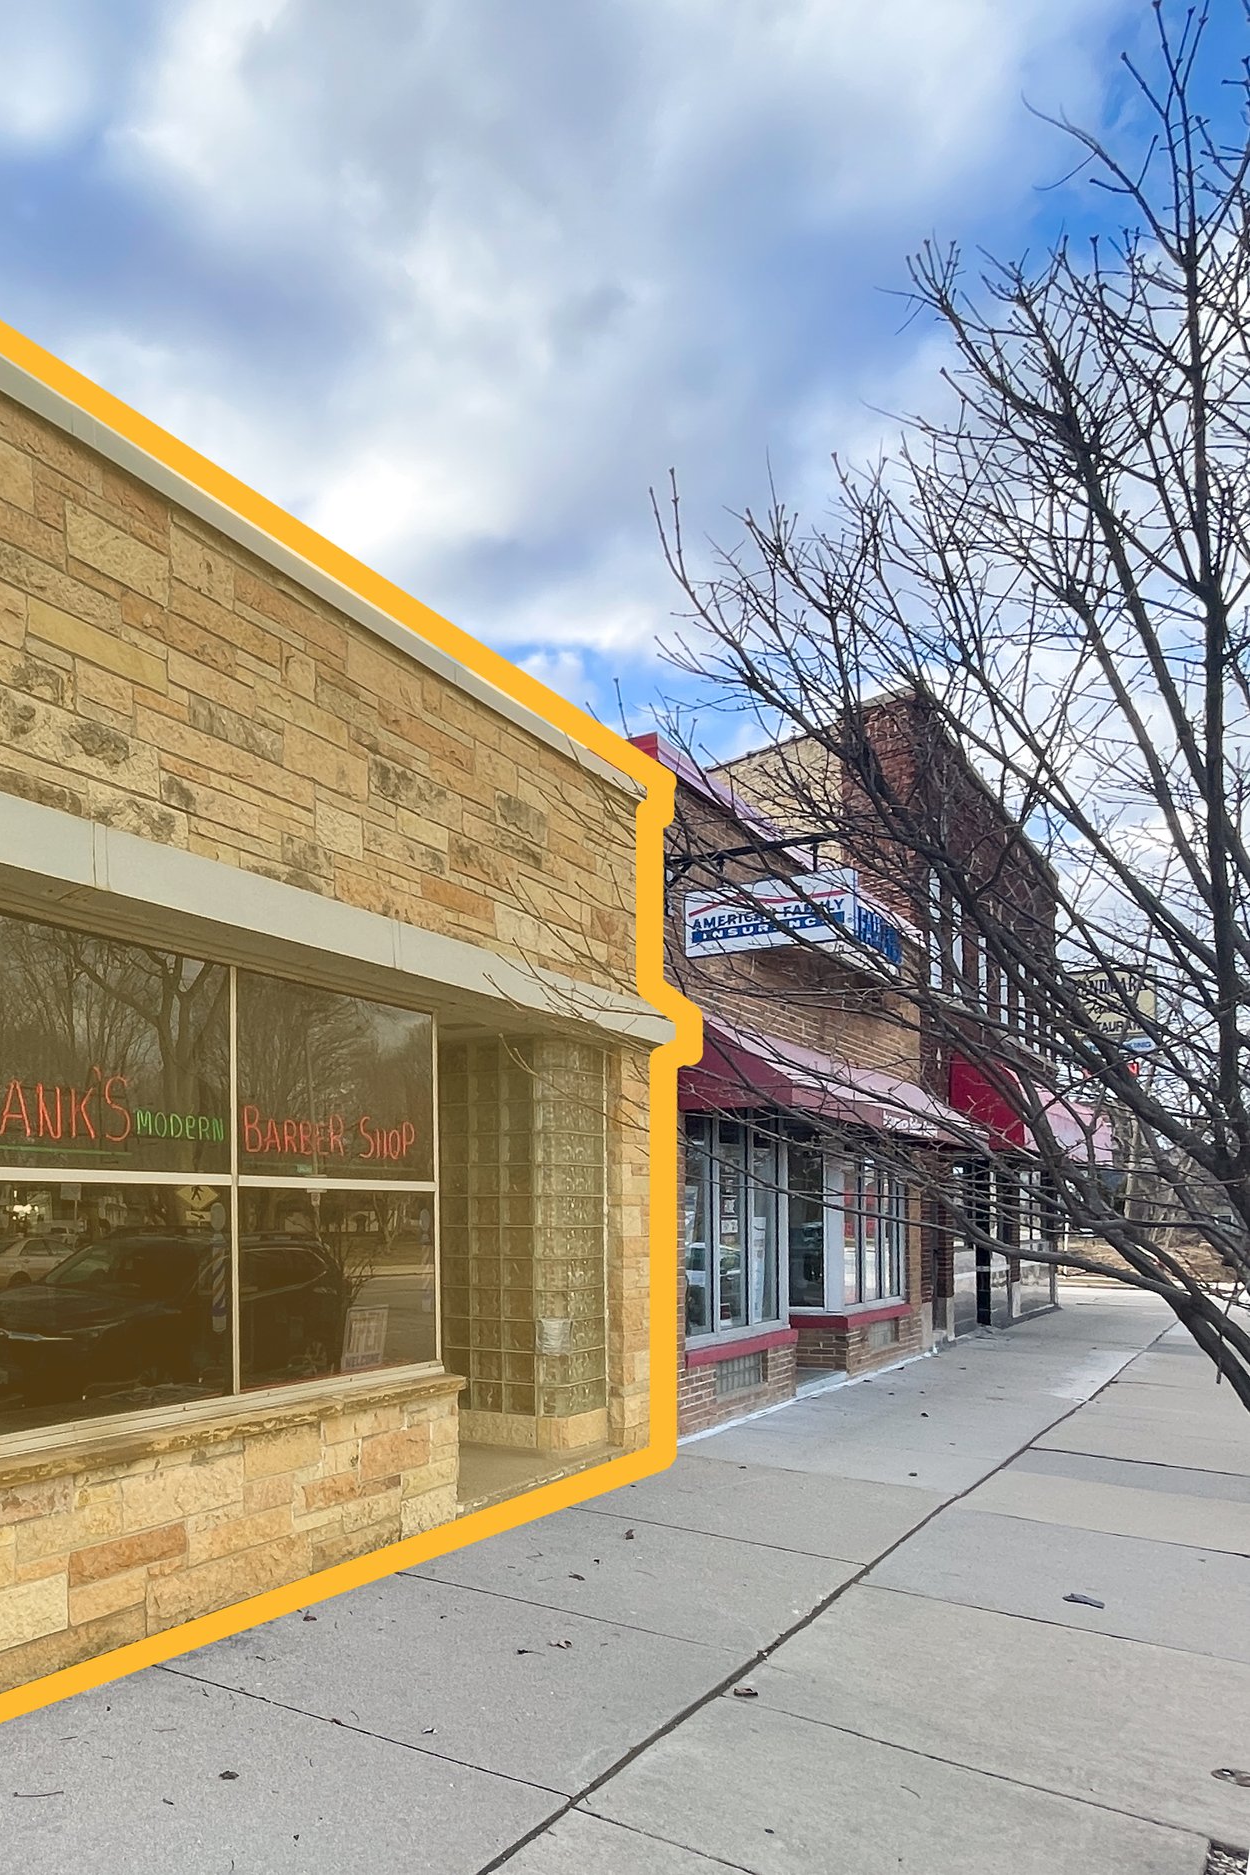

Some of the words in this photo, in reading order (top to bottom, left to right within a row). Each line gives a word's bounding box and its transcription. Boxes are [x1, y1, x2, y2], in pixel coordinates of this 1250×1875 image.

[703, 917, 829, 939] INSURNC
[135, 1108, 224, 1142] MODERN
[243, 1105, 344, 1157] BARBER
[359, 1116, 416, 1160] SHOP
